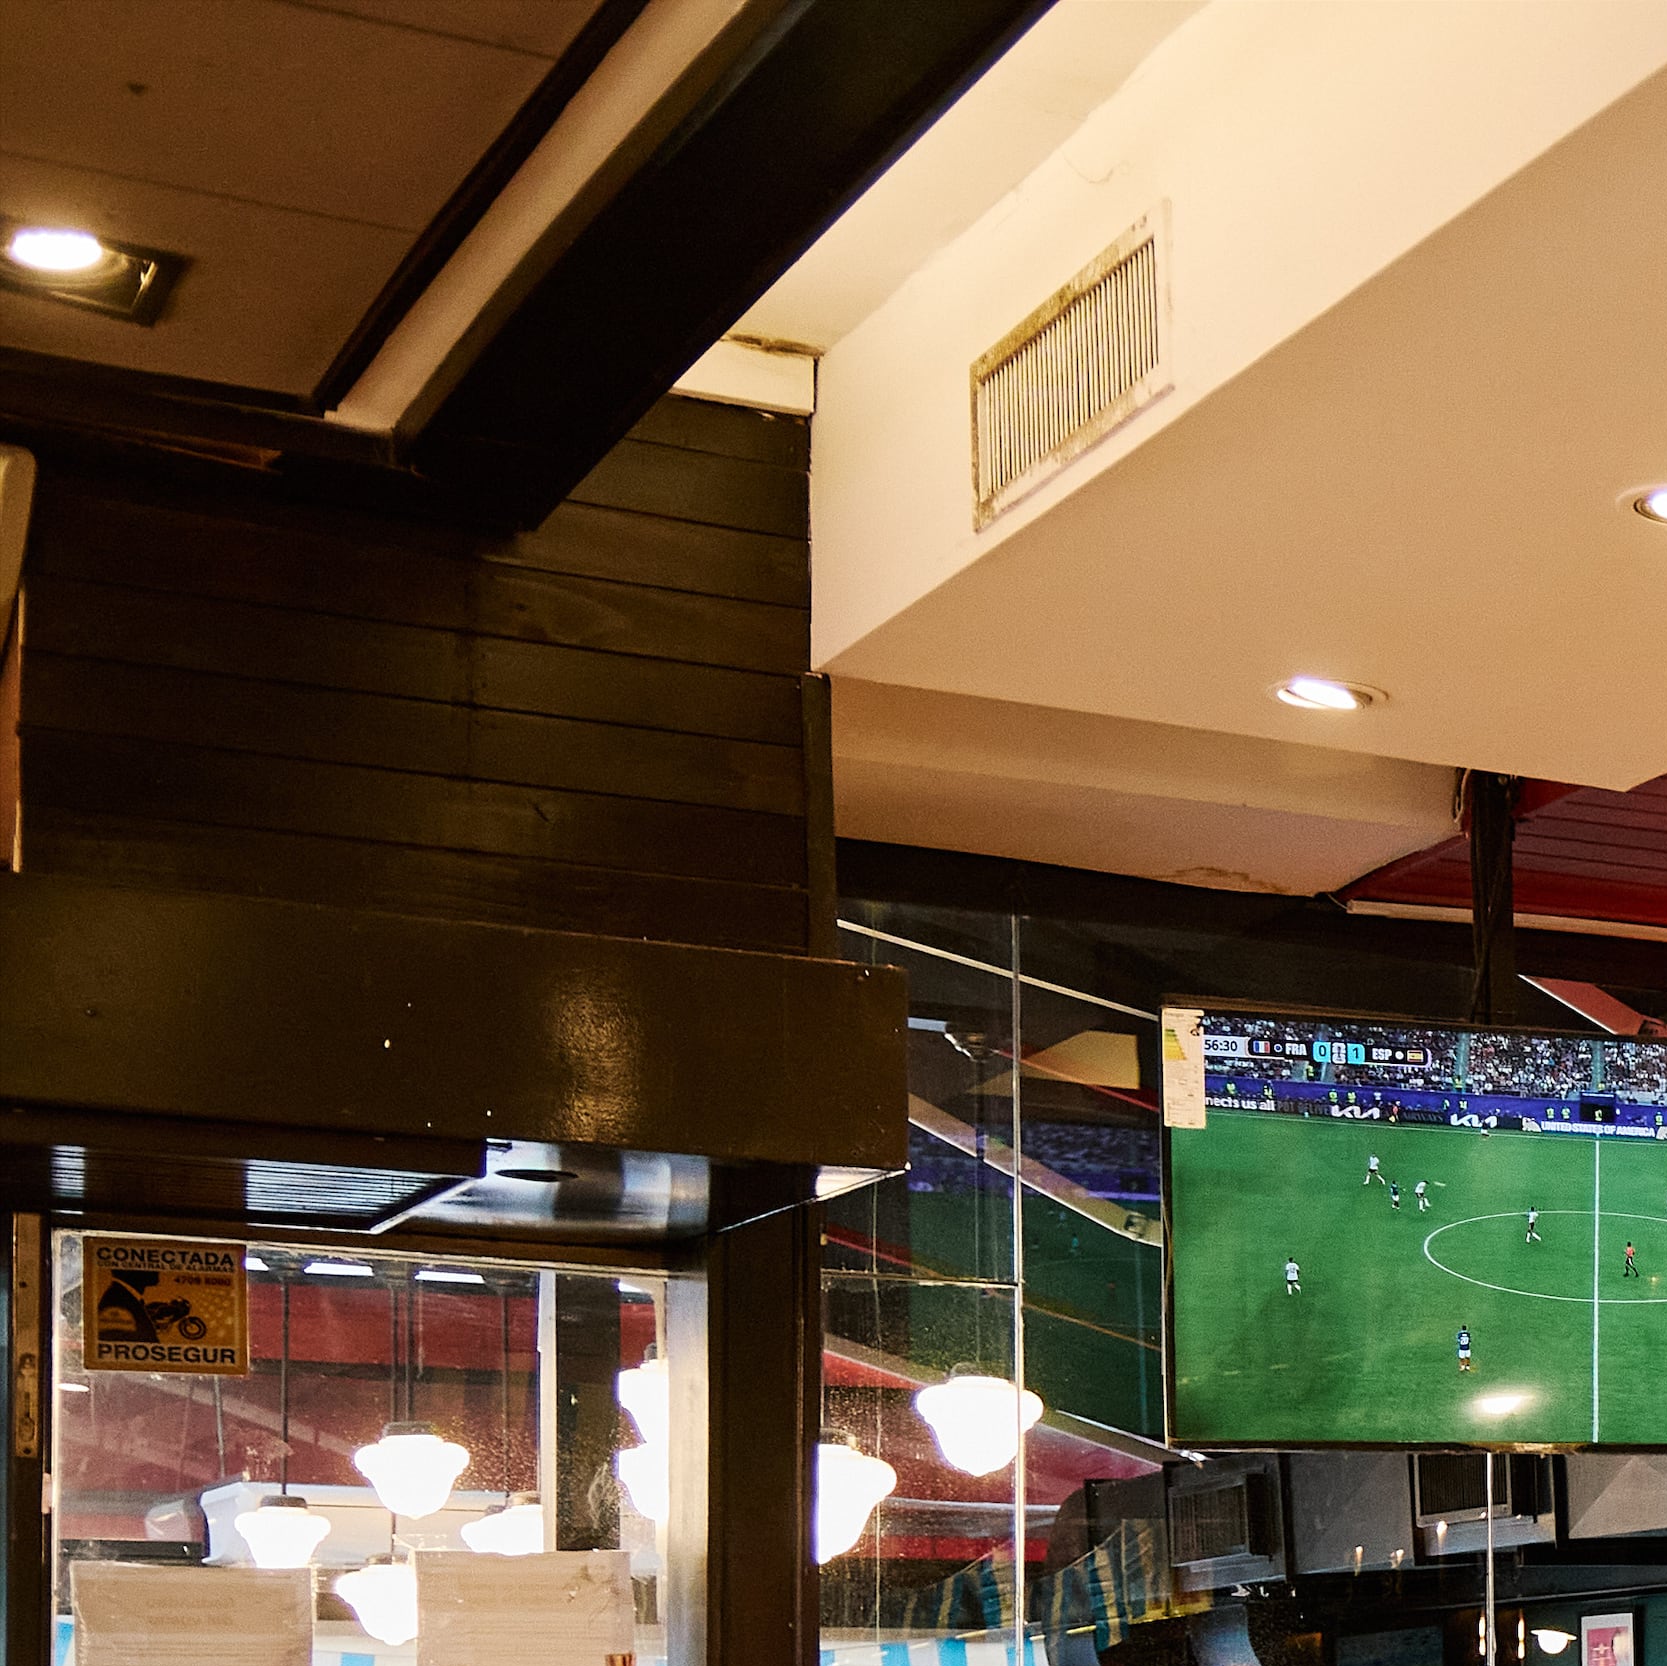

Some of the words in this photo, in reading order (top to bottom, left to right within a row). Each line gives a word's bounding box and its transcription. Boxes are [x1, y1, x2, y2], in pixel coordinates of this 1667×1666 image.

[1204, 1038, 1238, 1052] 56:30
[1285, 1042, 1308, 1057] FRA
[1319, 1043, 1327, 1057] 0
[1372, 1047, 1393, 1061] ESP
[1616, 1125, 1655, 1138] AMERICA
[96, 1247, 235, 1267] CONECTADA
[121, 1262, 166, 1271] CENTRAL
[185, 1265, 235, 1274] ALARMAS
[97, 1343, 236, 1364] PROSEGUR
